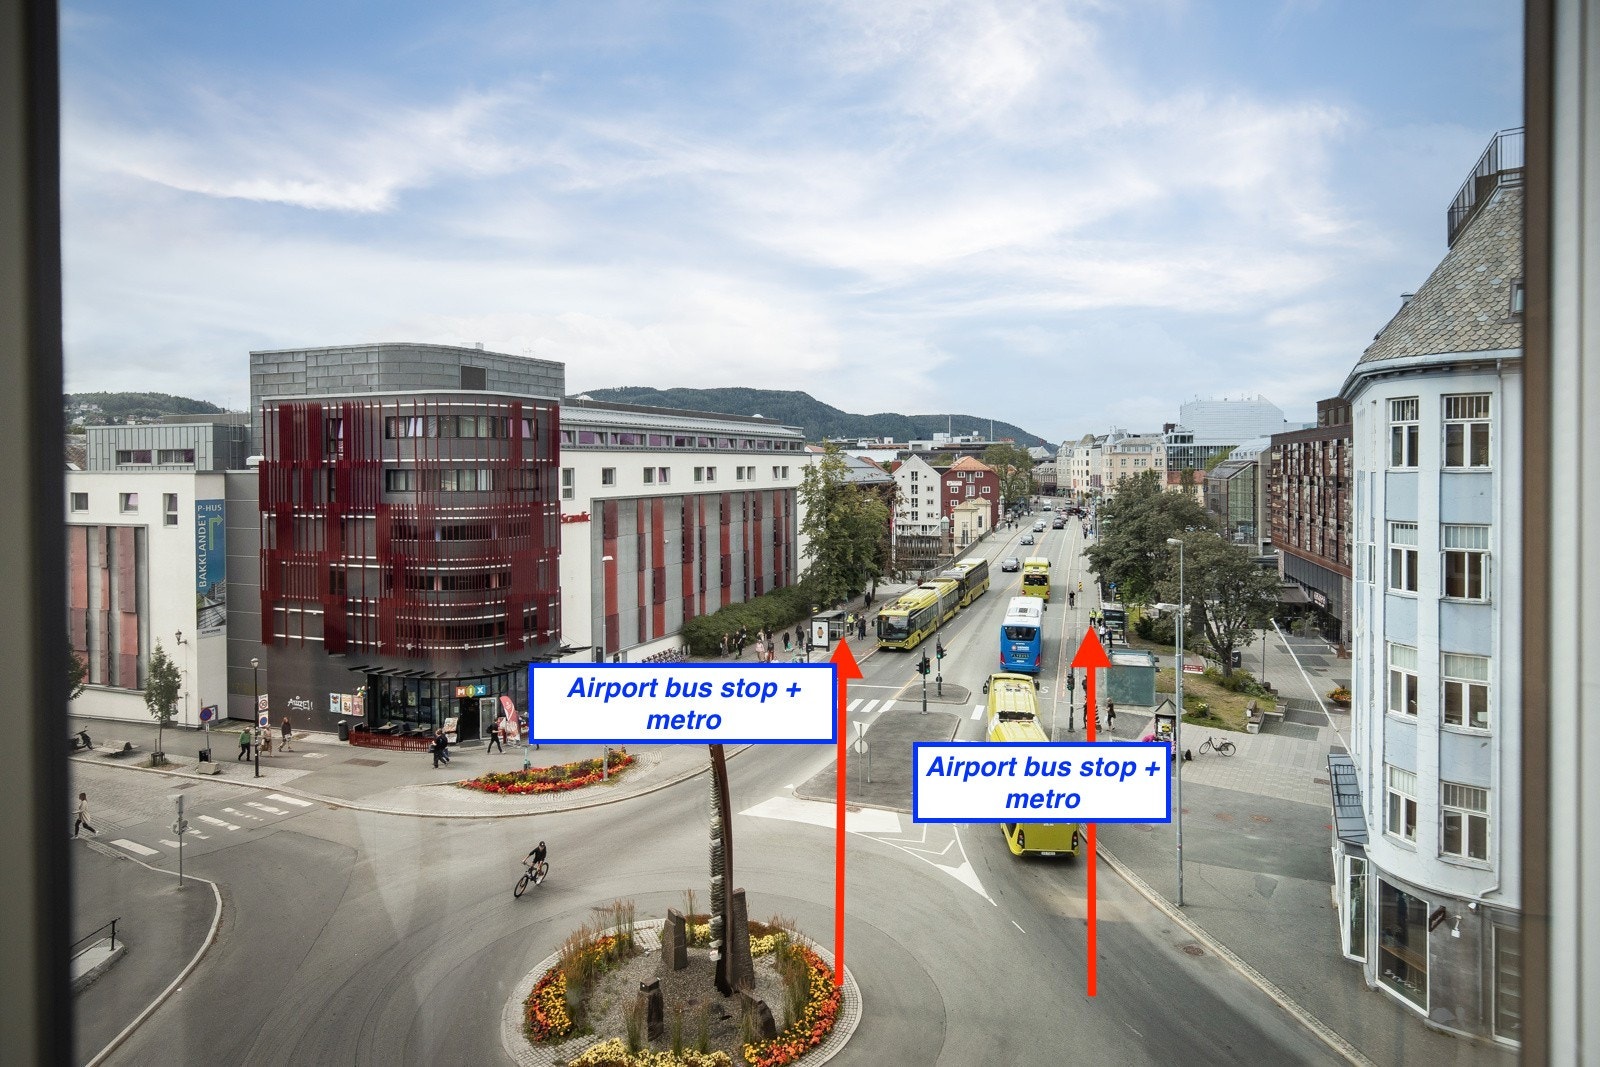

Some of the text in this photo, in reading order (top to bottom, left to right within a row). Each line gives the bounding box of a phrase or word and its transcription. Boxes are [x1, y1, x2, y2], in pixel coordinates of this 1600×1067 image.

[197, 504, 222, 512] P-HUS
[198, 514, 207, 588] BAKKLANDET
[457, 686, 484, 696] MIX
